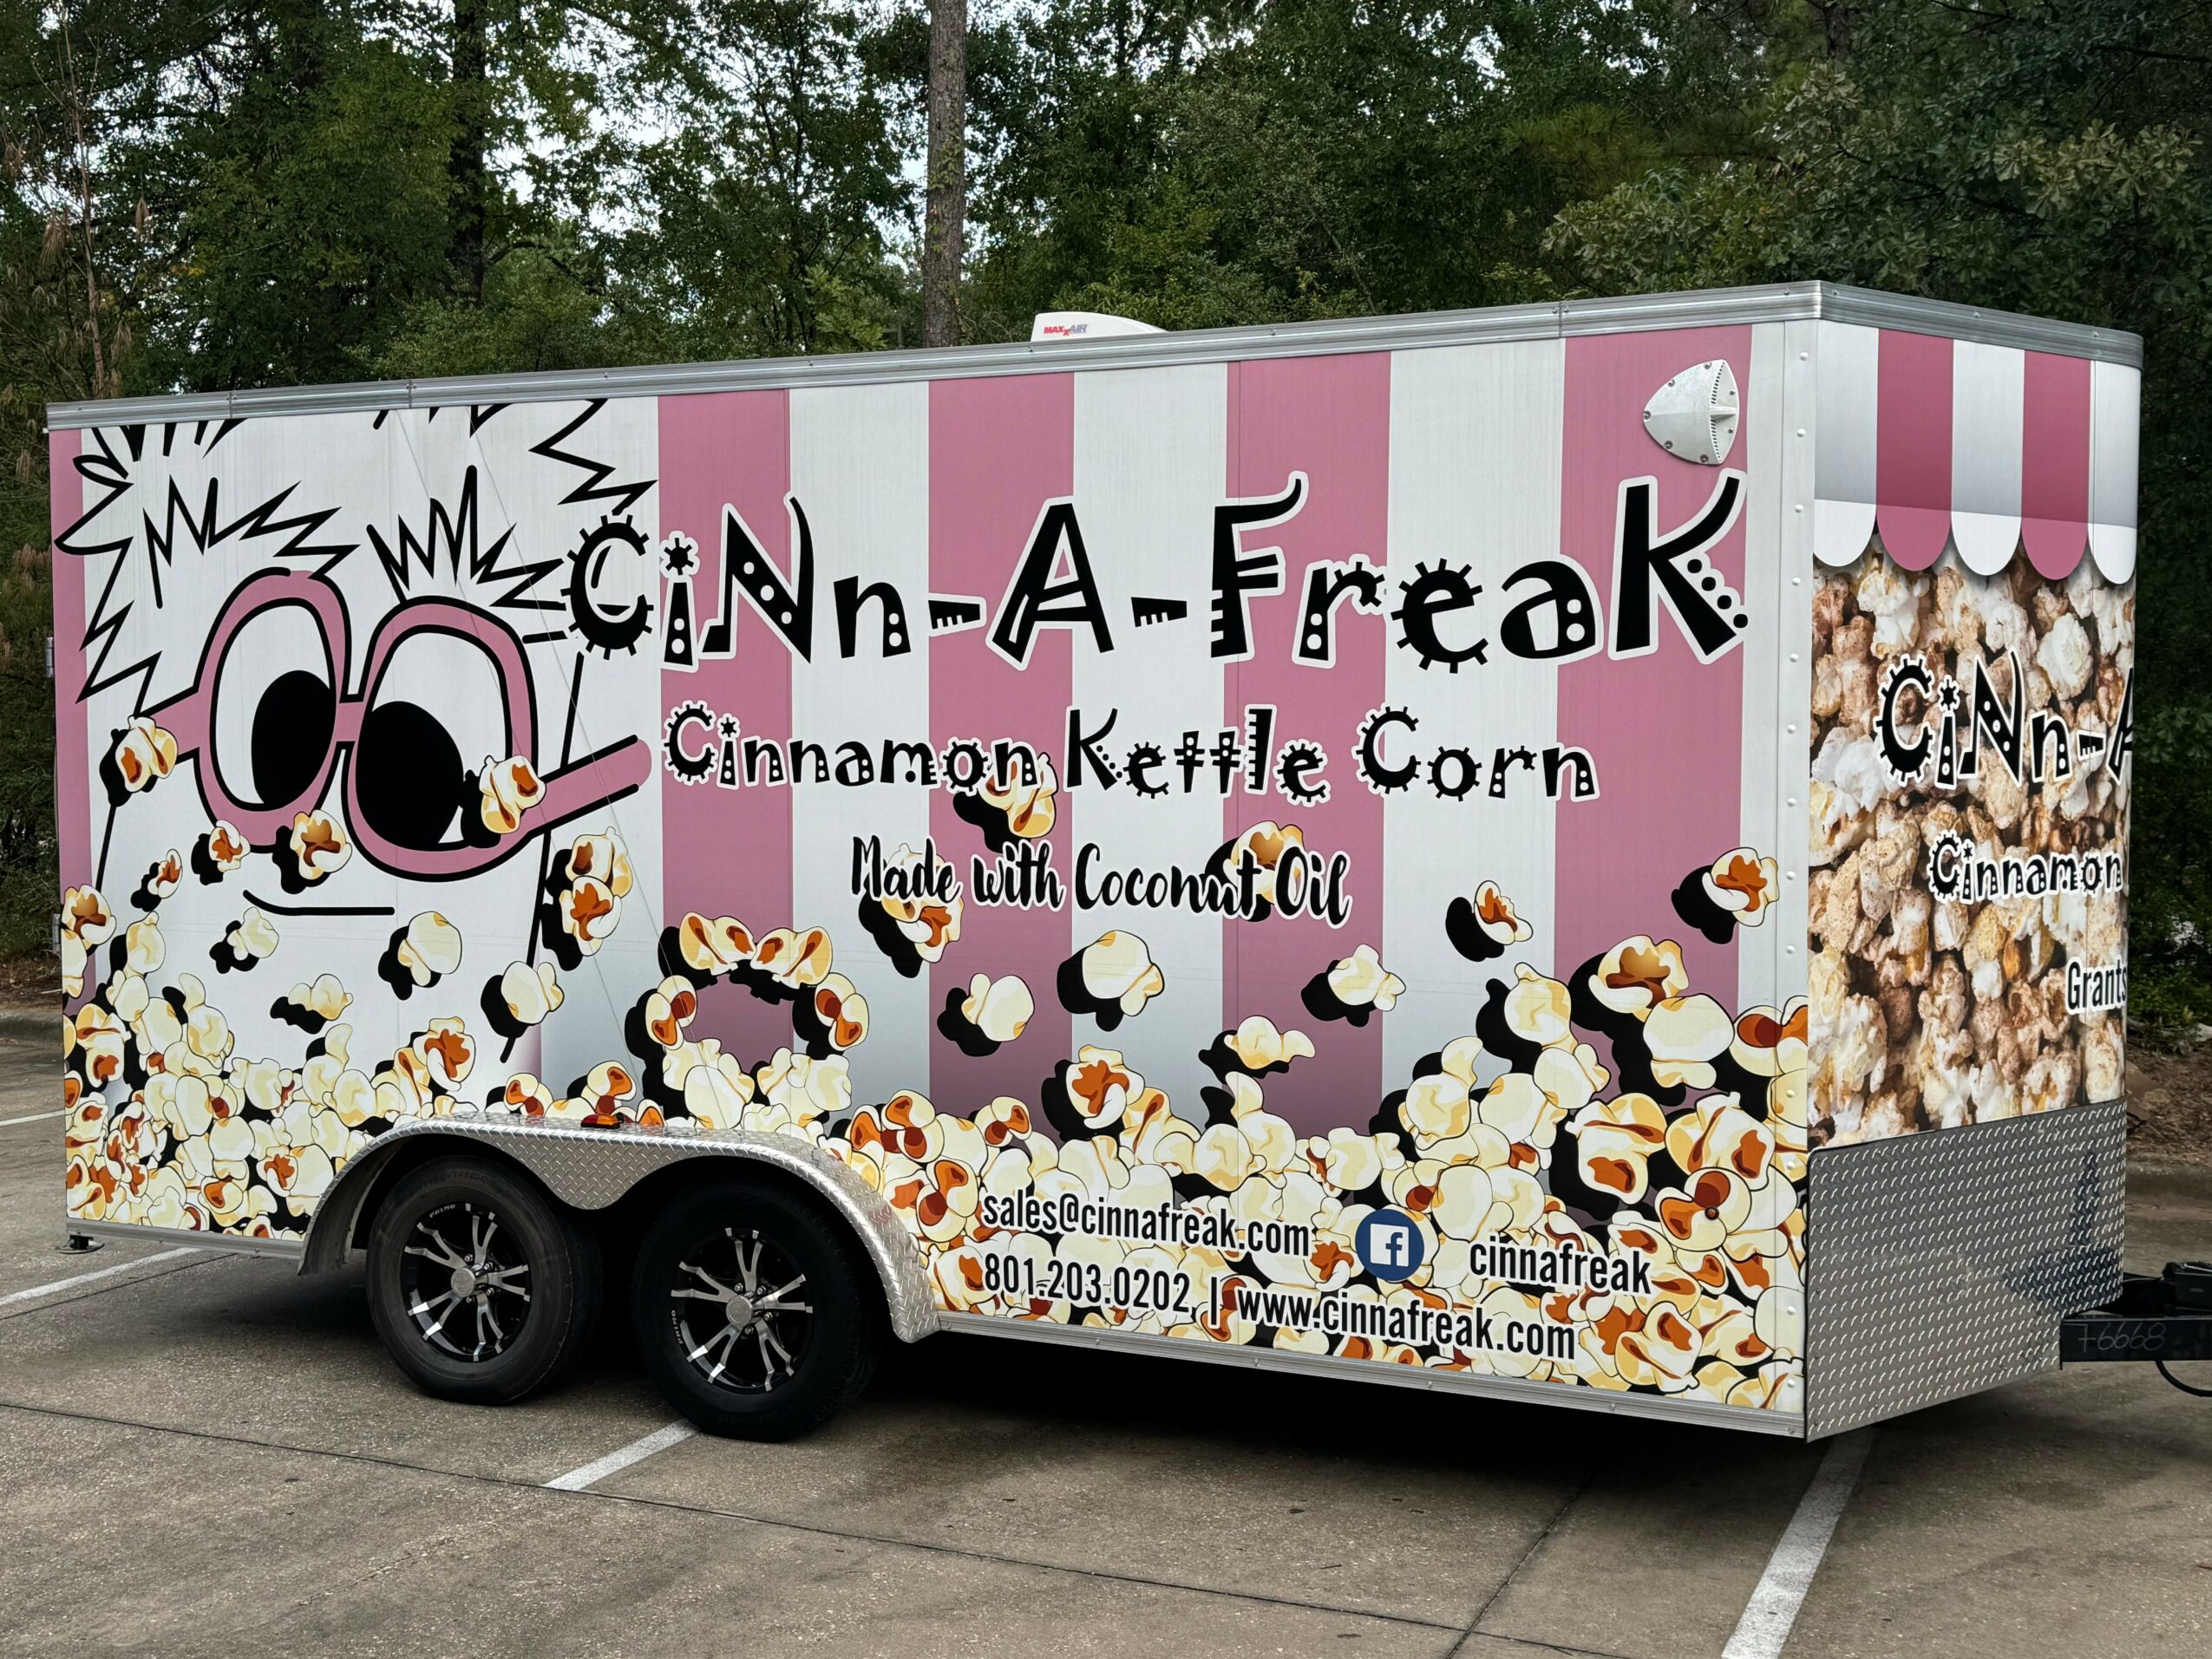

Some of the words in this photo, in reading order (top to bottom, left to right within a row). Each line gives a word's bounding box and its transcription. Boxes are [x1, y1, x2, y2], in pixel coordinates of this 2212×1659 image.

[664, 703, 1038, 794] Cinnamon
[1066, 708, 1330, 802] Kettle
[1353, 706, 1595, 801] Corn
[851, 835, 958, 901] Made
[972, 840, 1063, 909] with
[1075, 843, 1261, 917] Coconut
[1275, 846, 1351, 925] Oil
[1929, 829, 2123, 901] Cinnamon
[2067, 959, 2128, 1009] Grants
[429, 1204, 456, 1218] PRIMO
[983, 1189, 1309, 1257] sales@cinnafreak.com
[1469, 1235, 1651, 1295] cinnafreak
[984, 1252, 1190, 1312] 801.203.0202
[1238, 1290, 1575, 1360] www.cinnafreak.com
